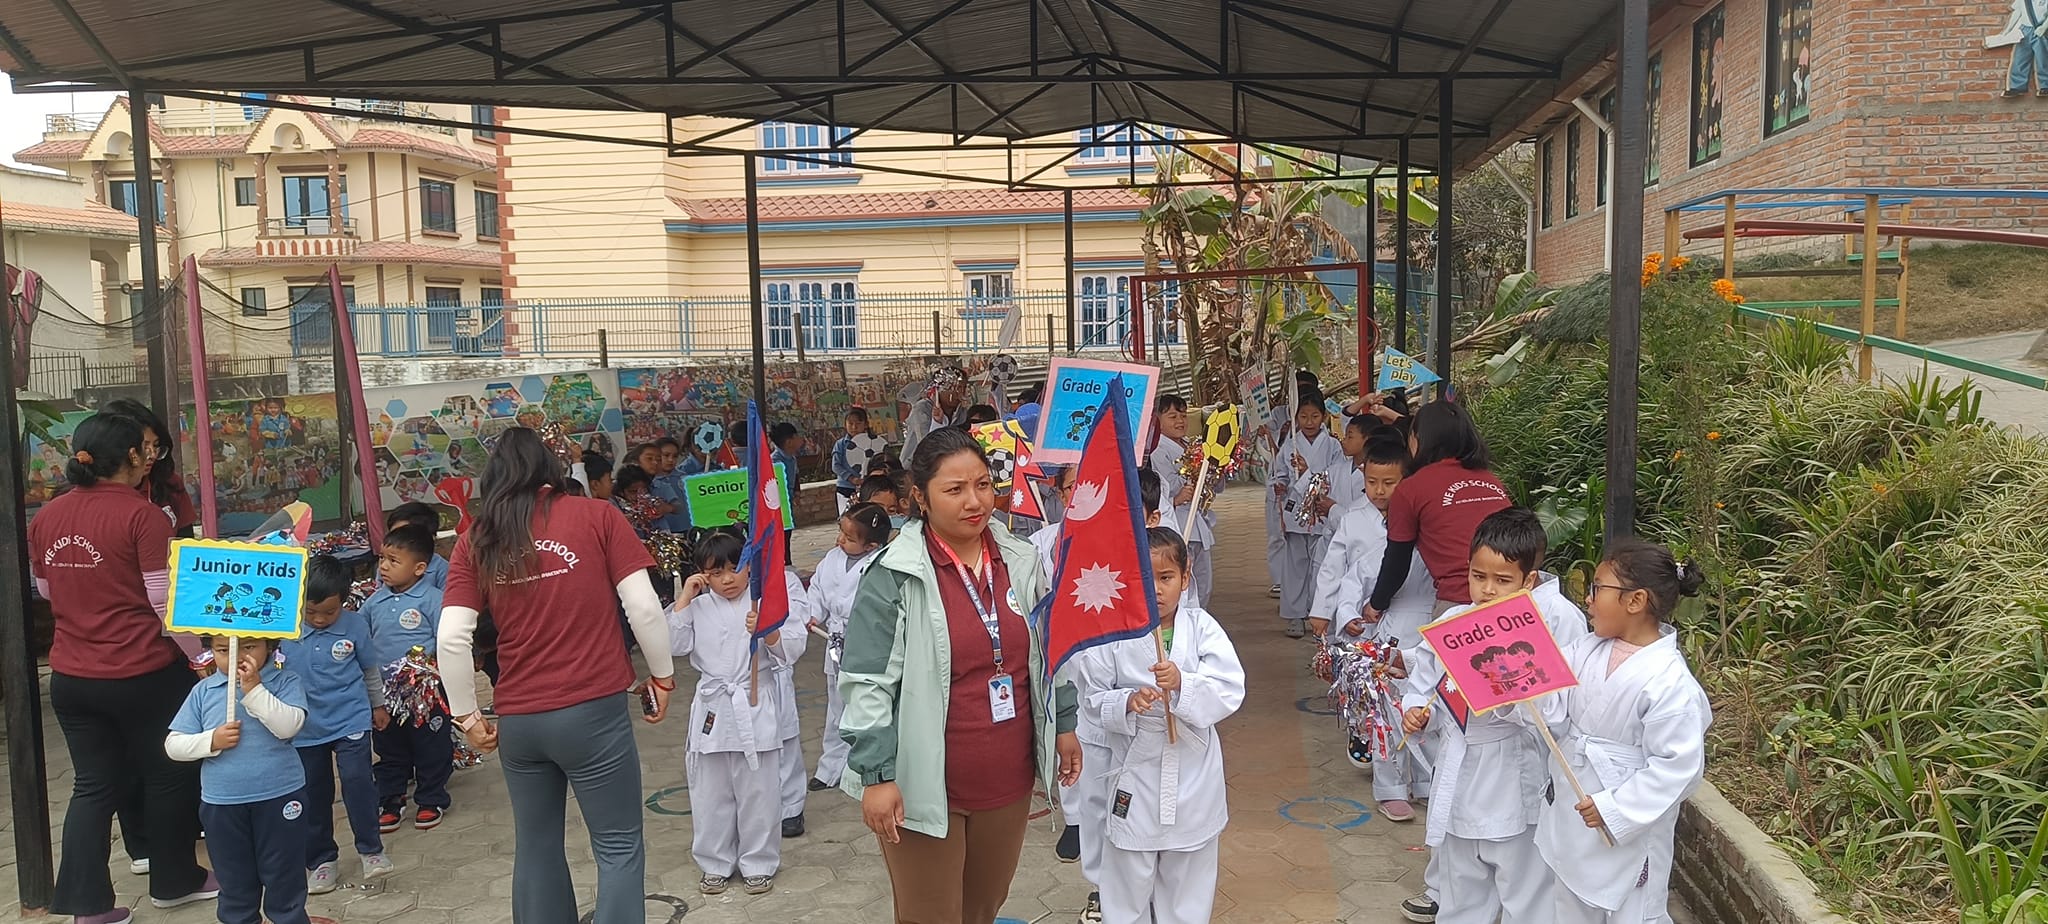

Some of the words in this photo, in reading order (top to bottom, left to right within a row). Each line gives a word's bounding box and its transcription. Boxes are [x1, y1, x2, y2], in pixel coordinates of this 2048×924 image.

[1386, 354, 1413, 369] Let's
[1062, 378, 1101, 394] Grade
[1390, 369, 1417, 384] play
[698, 480, 745, 496] Senior
[1442, 492, 1454, 506] WE
[1448, 480, 1469, 493] KIDS
[1468, 480, 1507, 498] SCHOOL
[73, 535, 103, 566] SCHOOL
[534, 540, 580, 569] SCHOOL
[192, 557, 251, 575] Junior
[257, 561, 297, 578] Kids
[1443, 623, 1496, 650] Grade
[1496, 611, 1536, 632] One
